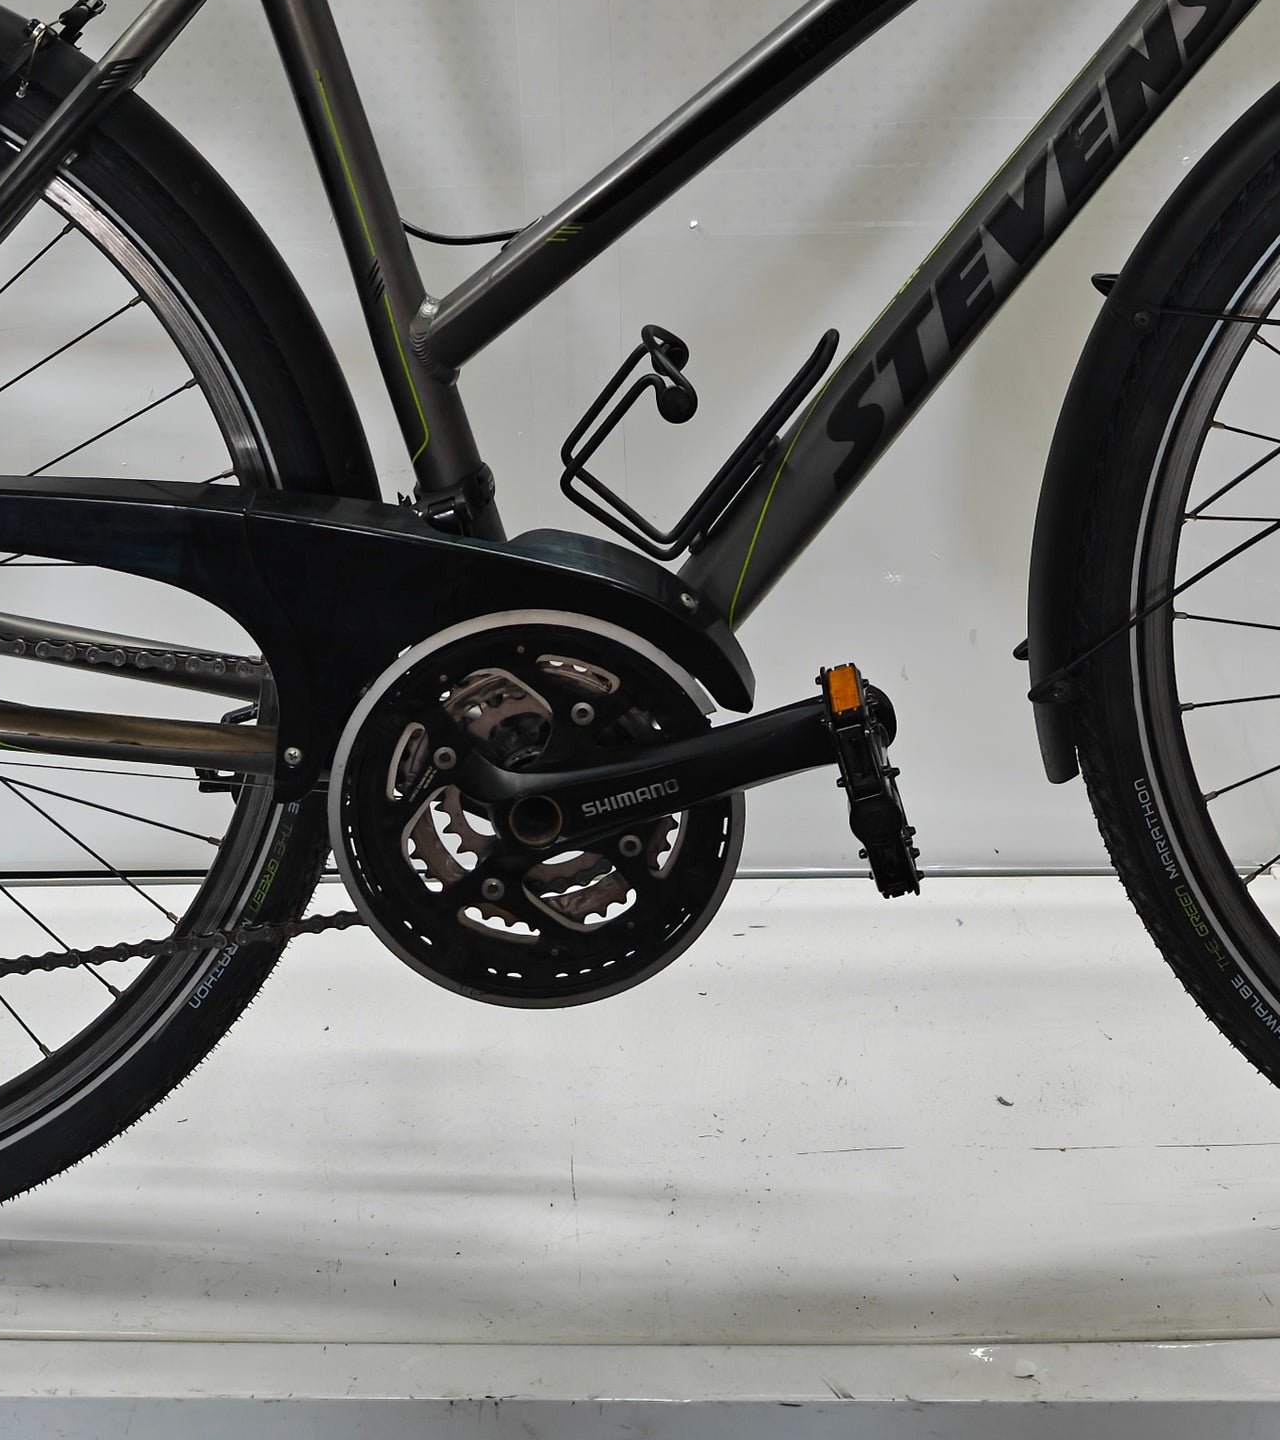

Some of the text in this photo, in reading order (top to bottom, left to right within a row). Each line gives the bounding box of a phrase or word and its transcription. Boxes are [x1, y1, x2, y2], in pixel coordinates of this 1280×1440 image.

[581, 778, 680, 817] SHIMANO
[273, 824, 294, 856] THE
[1134, 777, 1180, 880] MARATHON
[251, 860, 280, 913] GREEN
[1174, 883, 1210, 938] GREEN
[1204, 938, 1231, 972] THE
